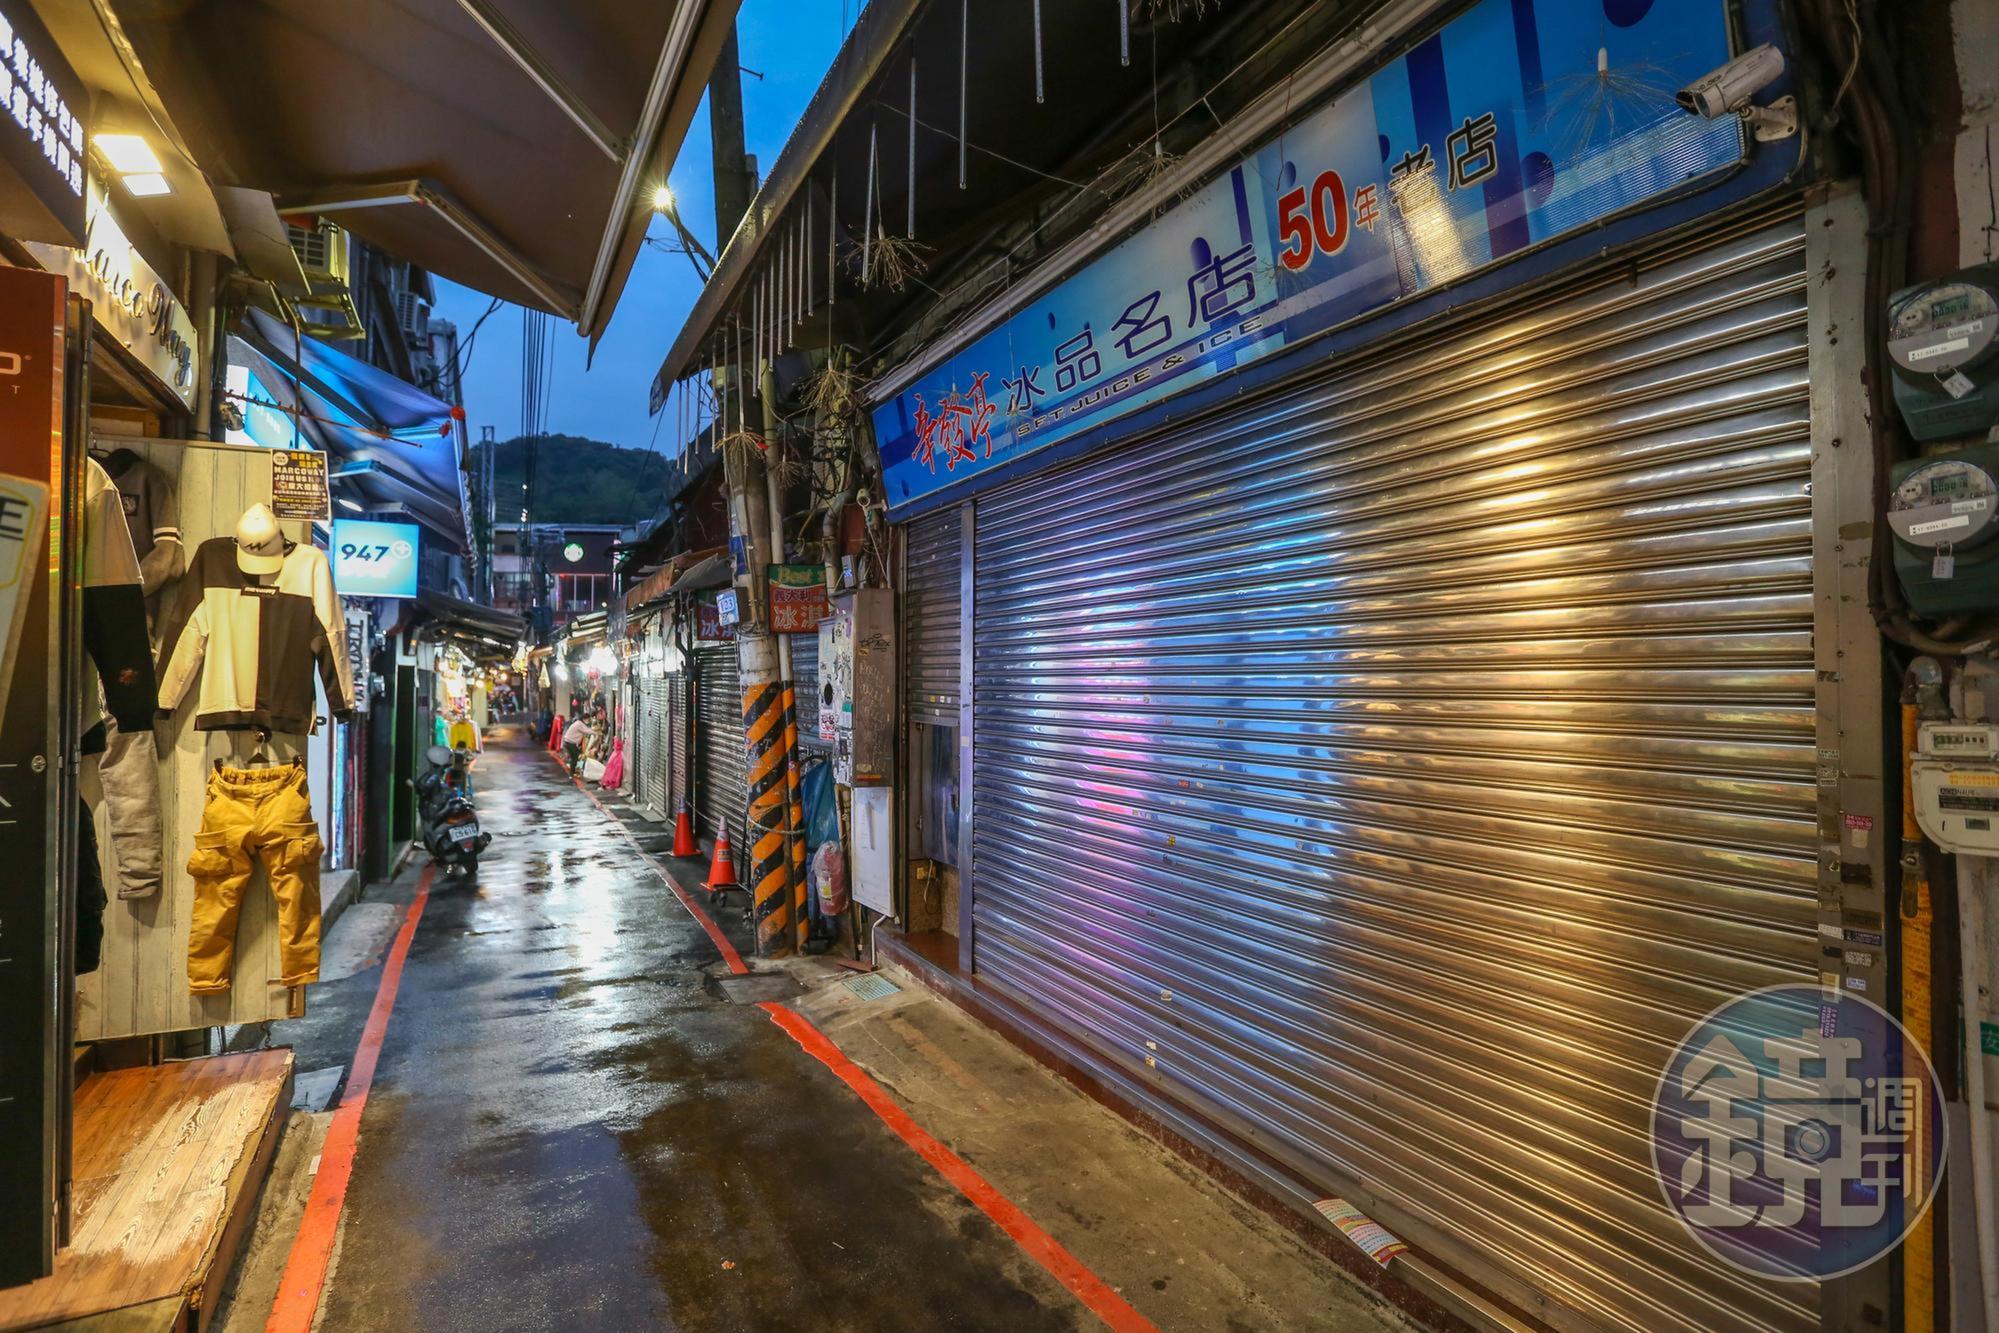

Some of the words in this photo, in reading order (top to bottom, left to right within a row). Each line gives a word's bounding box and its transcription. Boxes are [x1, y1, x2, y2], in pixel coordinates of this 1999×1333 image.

[1002, 243, 1257, 416] 冰品名店
[1071, 366, 1152, 413] JUICE
[1161, 354, 1185, 371] &
[1198, 316, 1264, 354] ICE
[341, 543, 390, 562] 947
